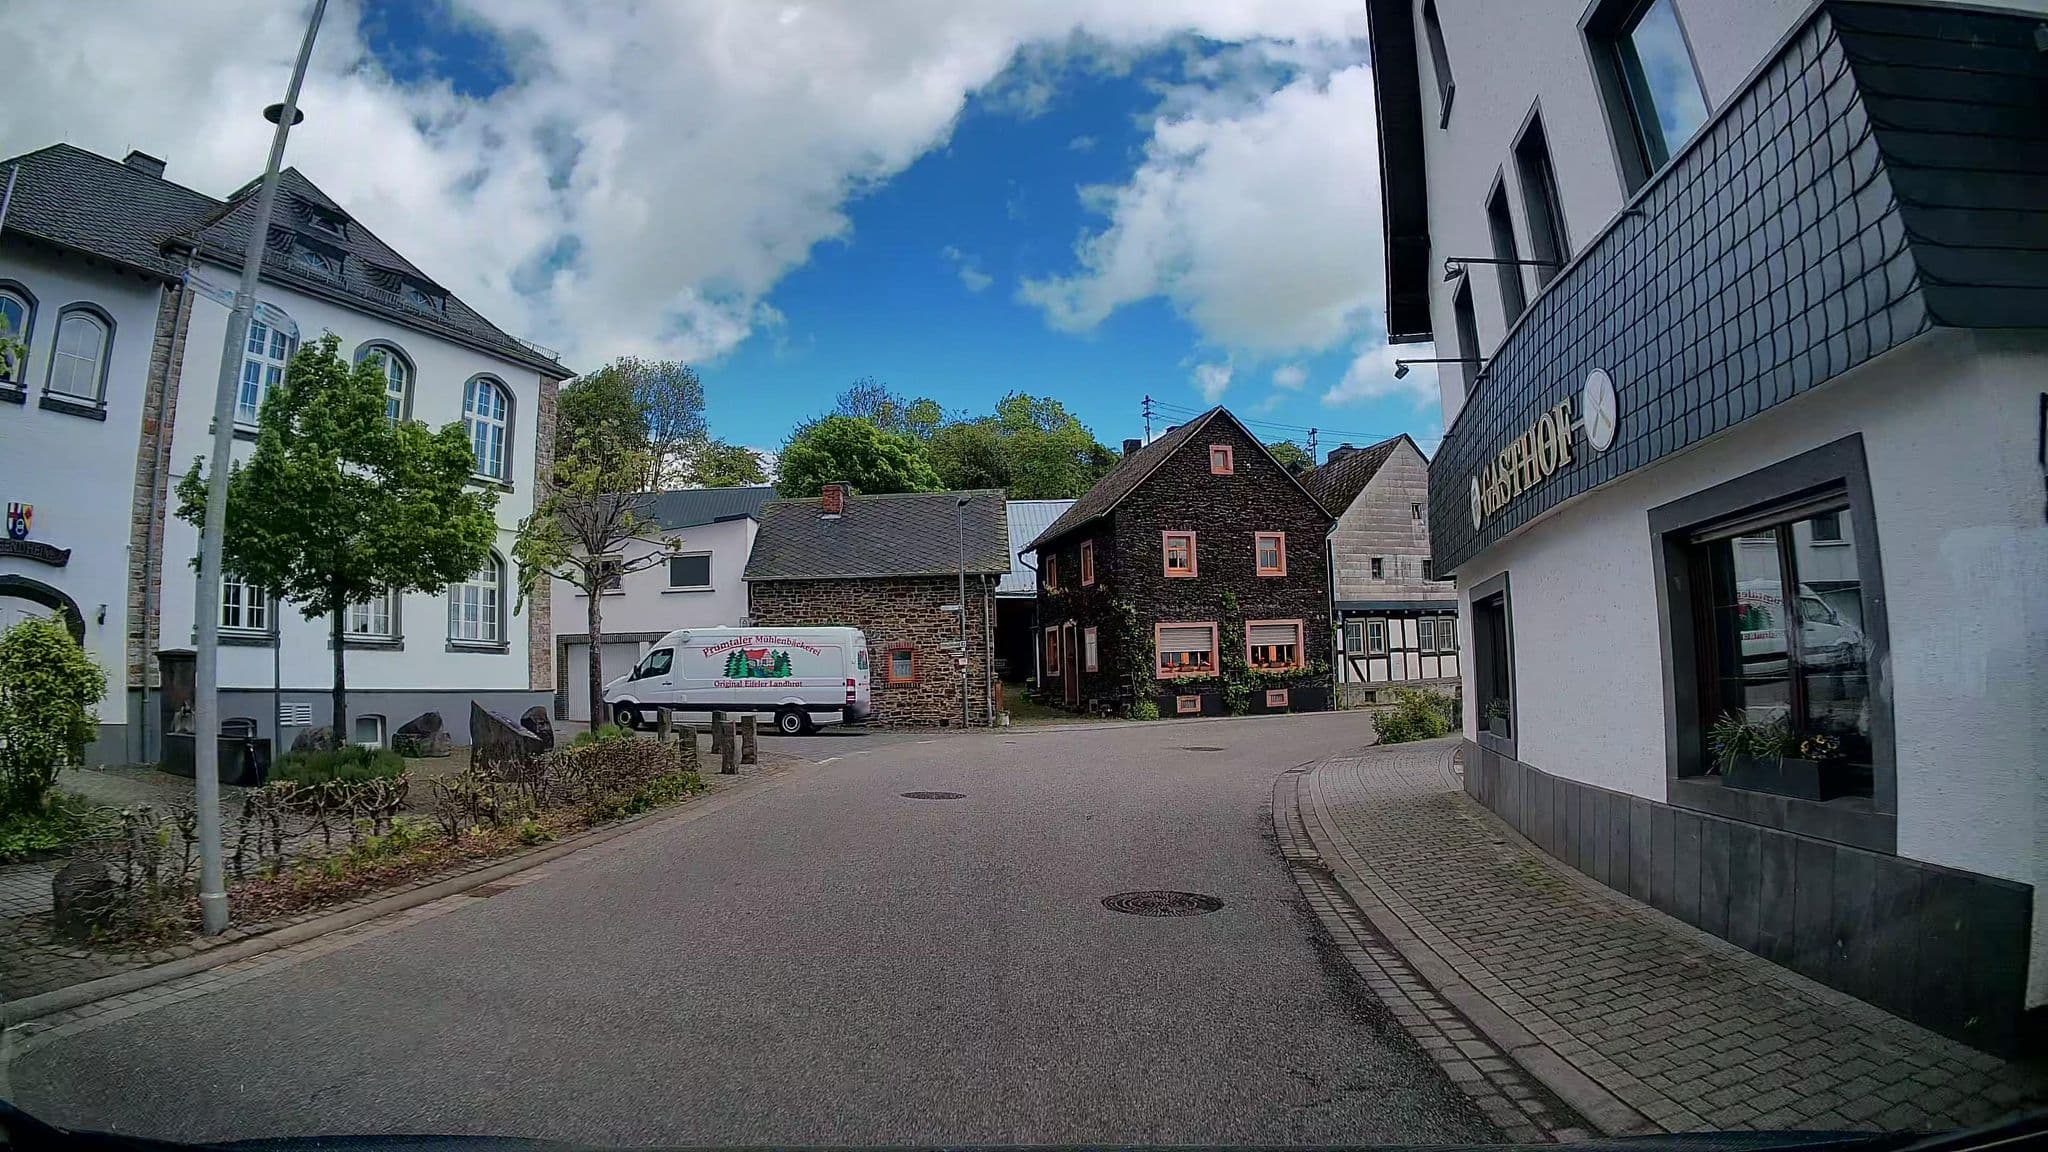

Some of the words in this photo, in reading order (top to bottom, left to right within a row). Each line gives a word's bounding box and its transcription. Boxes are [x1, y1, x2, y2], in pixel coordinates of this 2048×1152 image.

[1482, 396, 1573, 517] GASTHOF
[713, 680, 743, 688] Original
[769, 680, 803, 688] Landbrot
